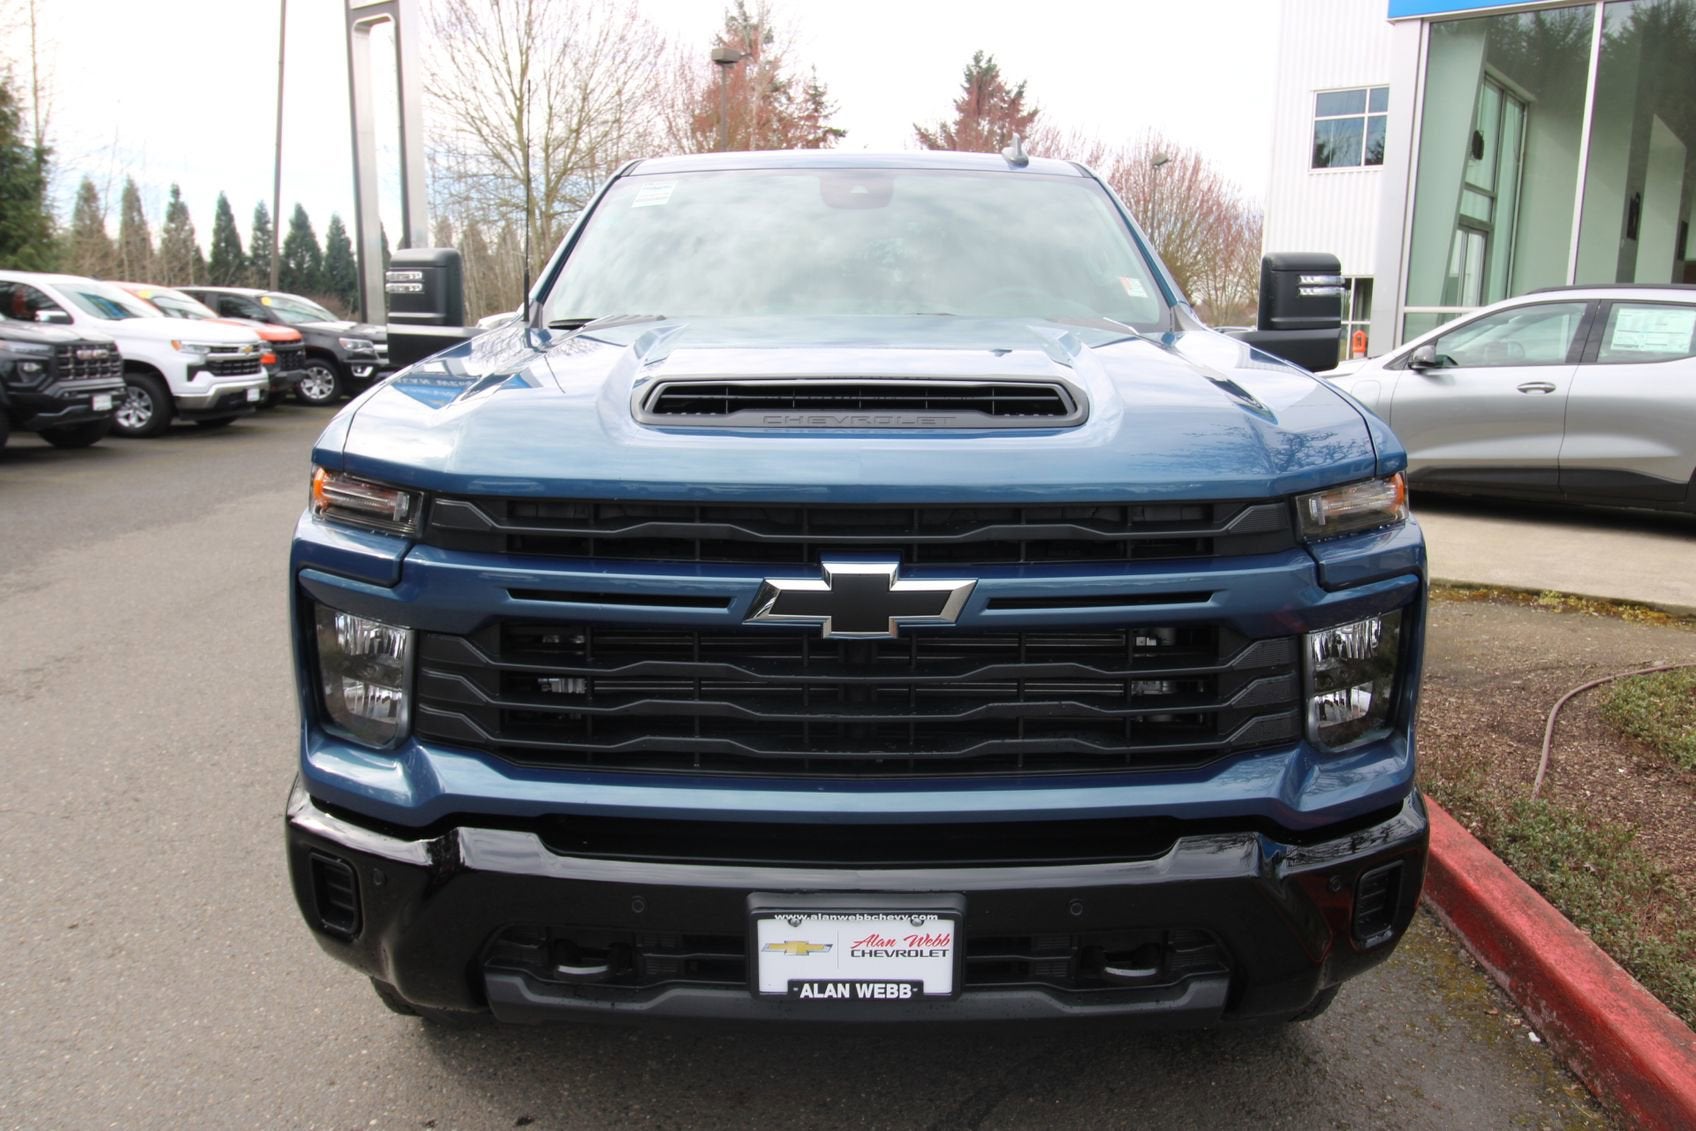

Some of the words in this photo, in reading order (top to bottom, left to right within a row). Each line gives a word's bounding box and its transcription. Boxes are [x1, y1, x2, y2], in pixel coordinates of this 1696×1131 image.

[763, 416, 957, 425] CHEVROLET
[850, 934, 896, 949] Alan
[903, 933, 951, 948] Webb
[850, 949, 950, 957] CHEVROLET
